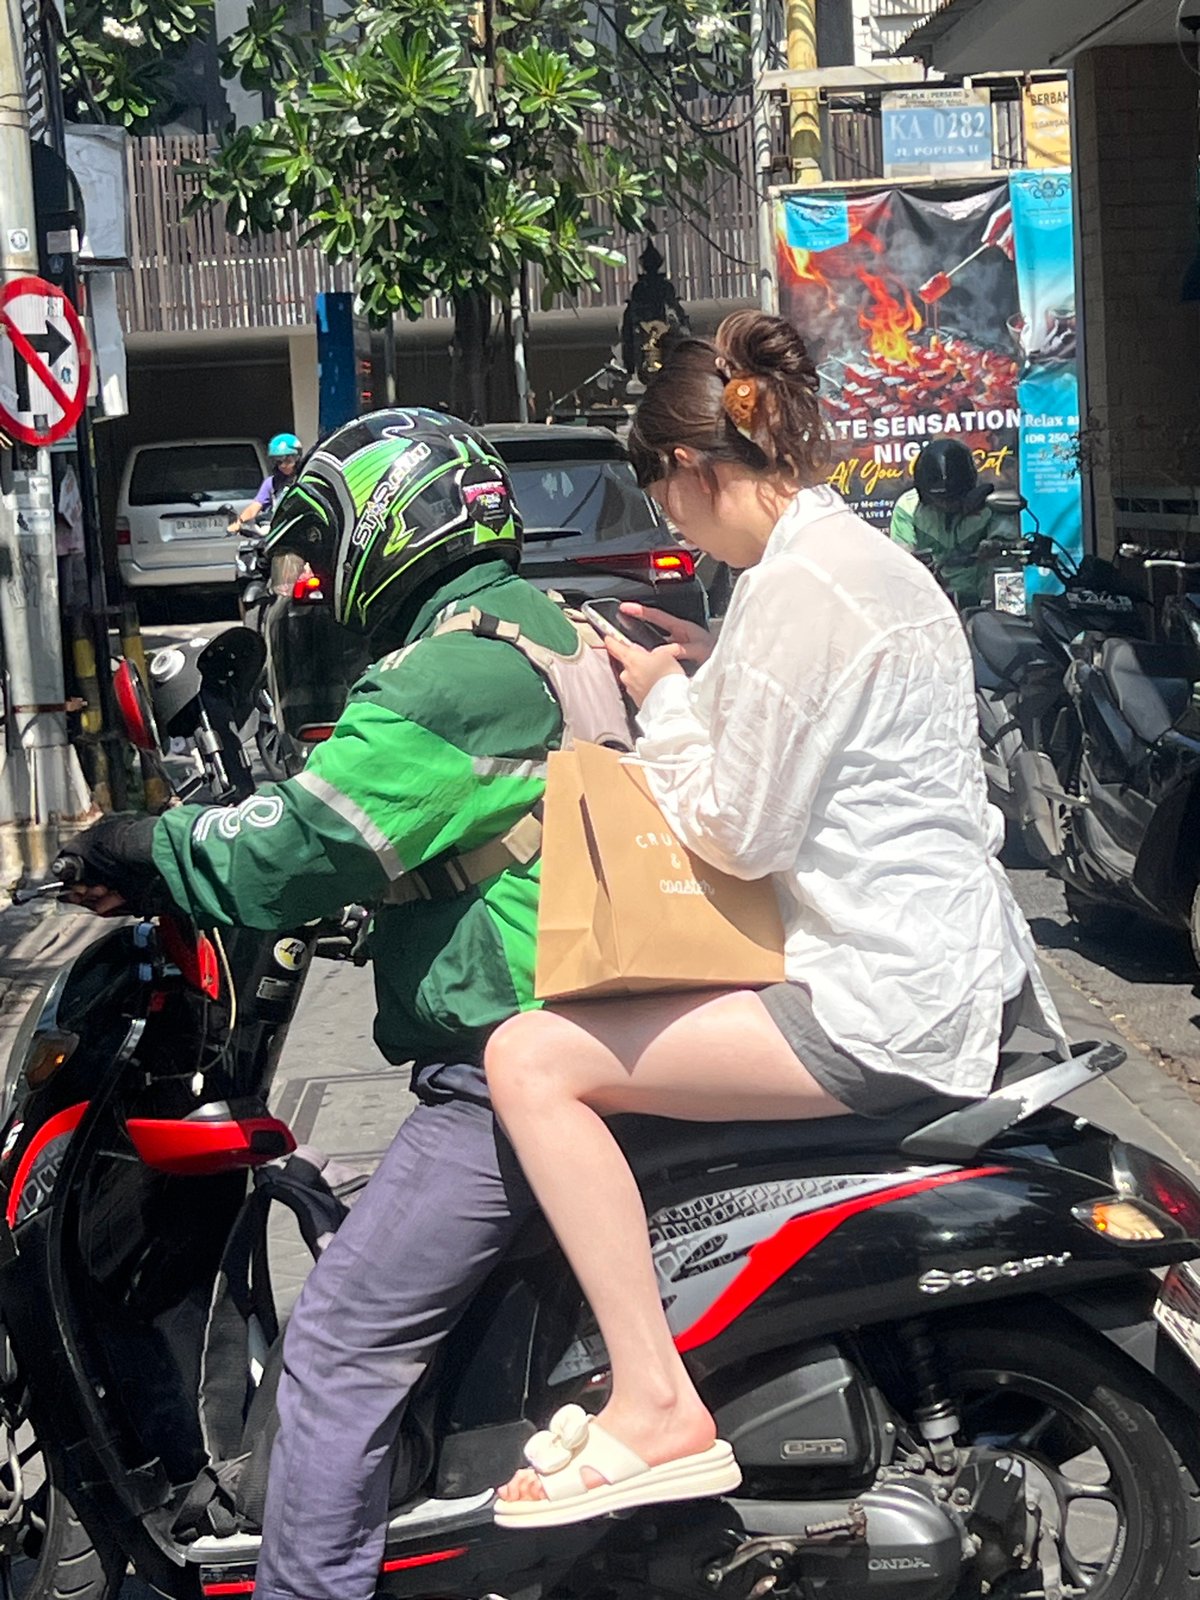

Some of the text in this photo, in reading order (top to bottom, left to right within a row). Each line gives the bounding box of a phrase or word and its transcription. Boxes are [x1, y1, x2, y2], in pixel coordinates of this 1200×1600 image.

[889, 112, 986, 140] KA 0282
[802, 408, 1021, 441] ATE SENSATION
[1025, 414, 1063, 428] Relax
[1025, 434, 1046, 444] IDR
[1048, 432, 1069, 443] 250
[874, 440, 929, 464] NIG
[860, 460, 904, 495] You
[635, 832, 680, 848] CRU
[867, 1556, 931, 1571] ONDA
